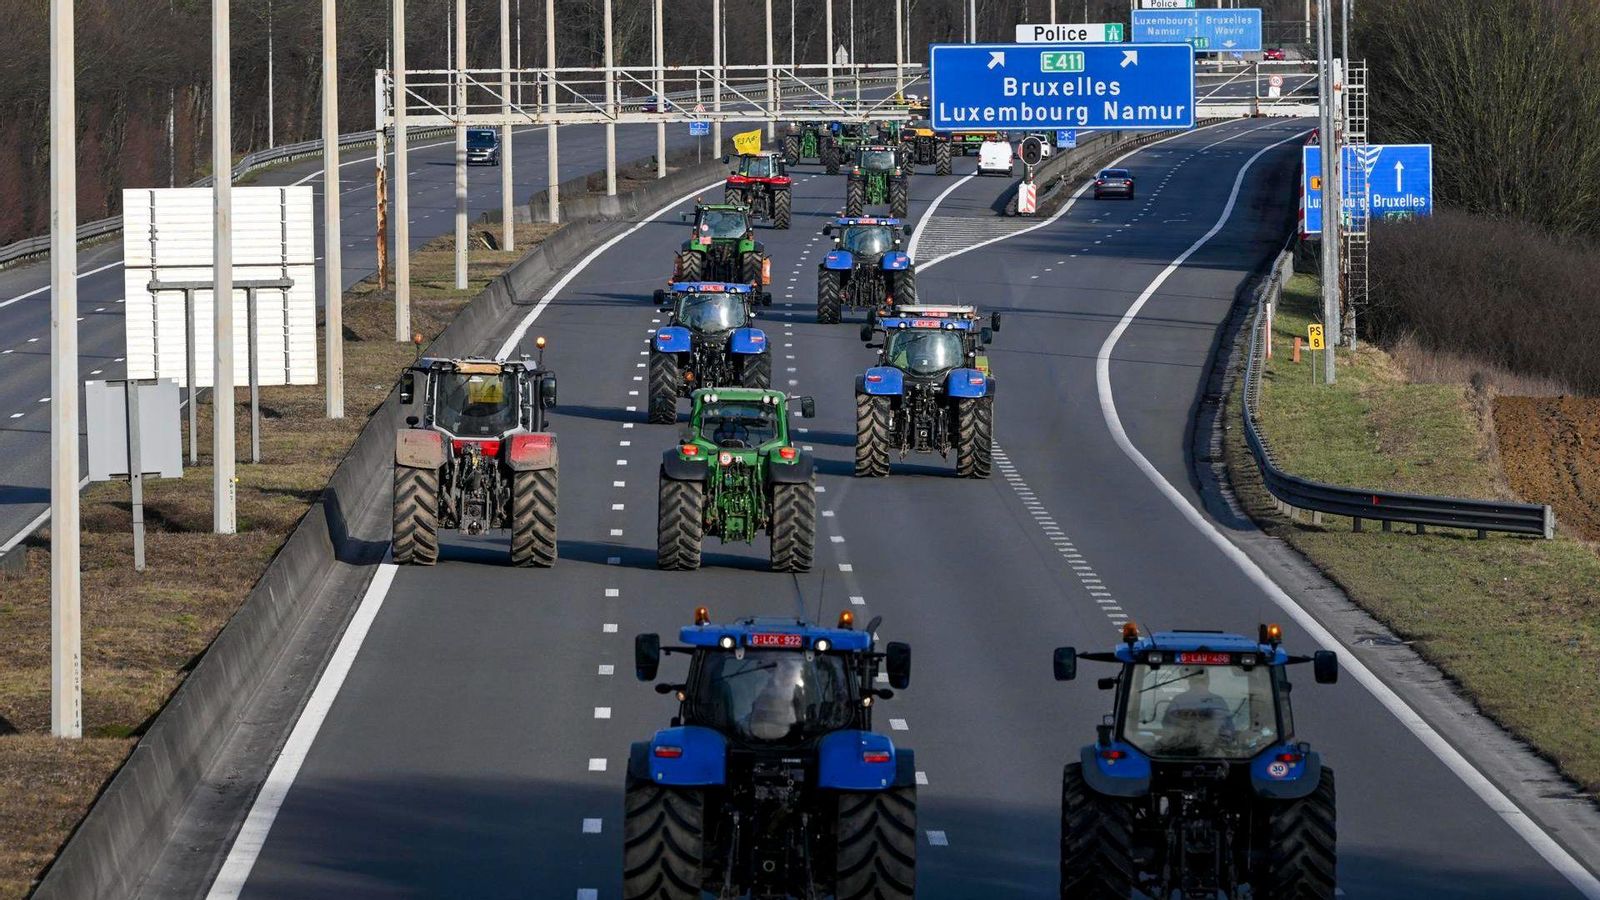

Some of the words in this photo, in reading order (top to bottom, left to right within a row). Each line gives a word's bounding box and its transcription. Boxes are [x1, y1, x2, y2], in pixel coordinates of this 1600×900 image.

[1151, 0, 1178, 8] Police
[1134, 17, 1193, 26] Luxembourg
[1206, 15, 1253, 24] Bruxelles
[1034, 26, 1087, 41] Police
[1147, 27, 1181, 36] Namur
[1003, 76, 1121, 96] Bruxelles
[940, 102, 1088, 126] Luxembourg
[1104, 101, 1185, 120] Namur
[1373, 193, 1426, 208] Bruxelles
[1310, 326, 1321, 336] PS
[1313, 338, 1320, 347] 8
